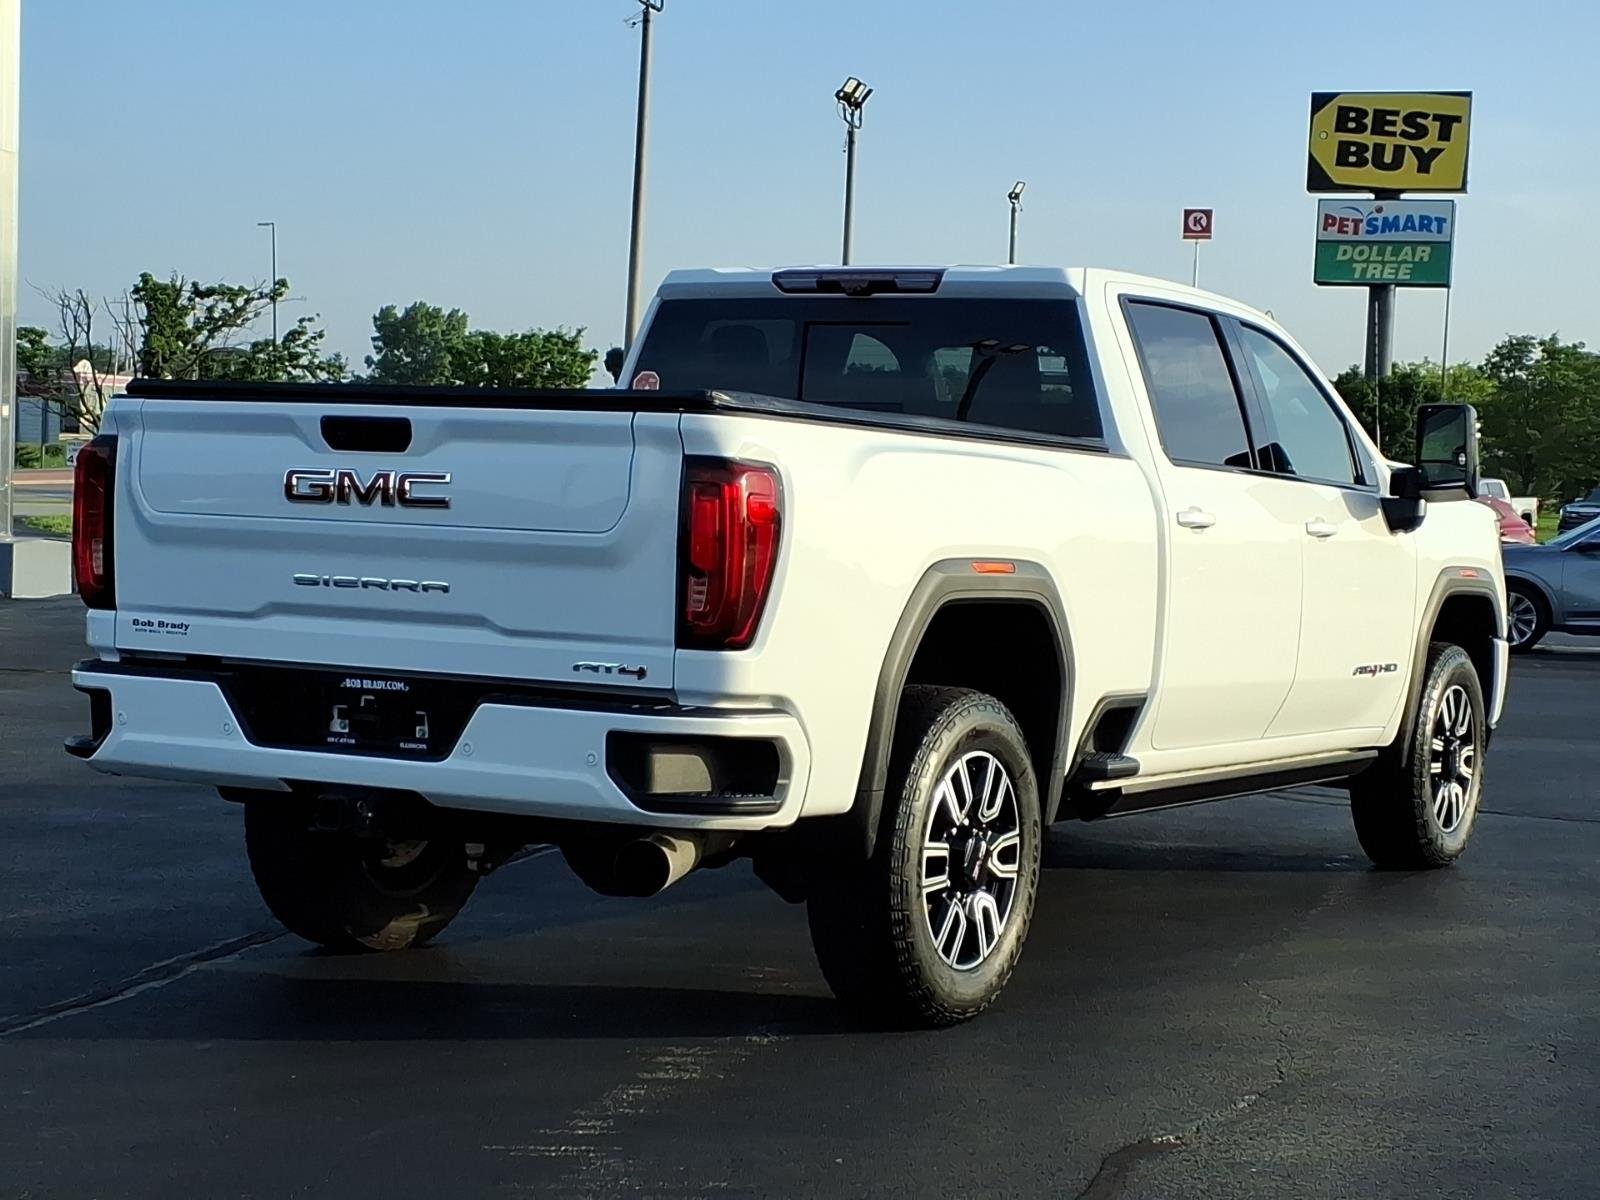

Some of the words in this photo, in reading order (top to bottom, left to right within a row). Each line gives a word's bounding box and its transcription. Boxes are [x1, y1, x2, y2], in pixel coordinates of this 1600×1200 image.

[1334, 105, 1462, 142] BEST
[1335, 140, 1446, 174] BUY
[1322, 212, 1447, 236] PETSMART
[1336, 245, 1431, 262] DOLLAR
[1352, 262, 1413, 280] TREE
[284, 467, 452, 509] GMC
[292, 573, 450, 594] SIERRA
[132, 618, 155, 627] Bob
[157, 620, 190, 631] Brady
[572, 661, 648, 681] AT4
